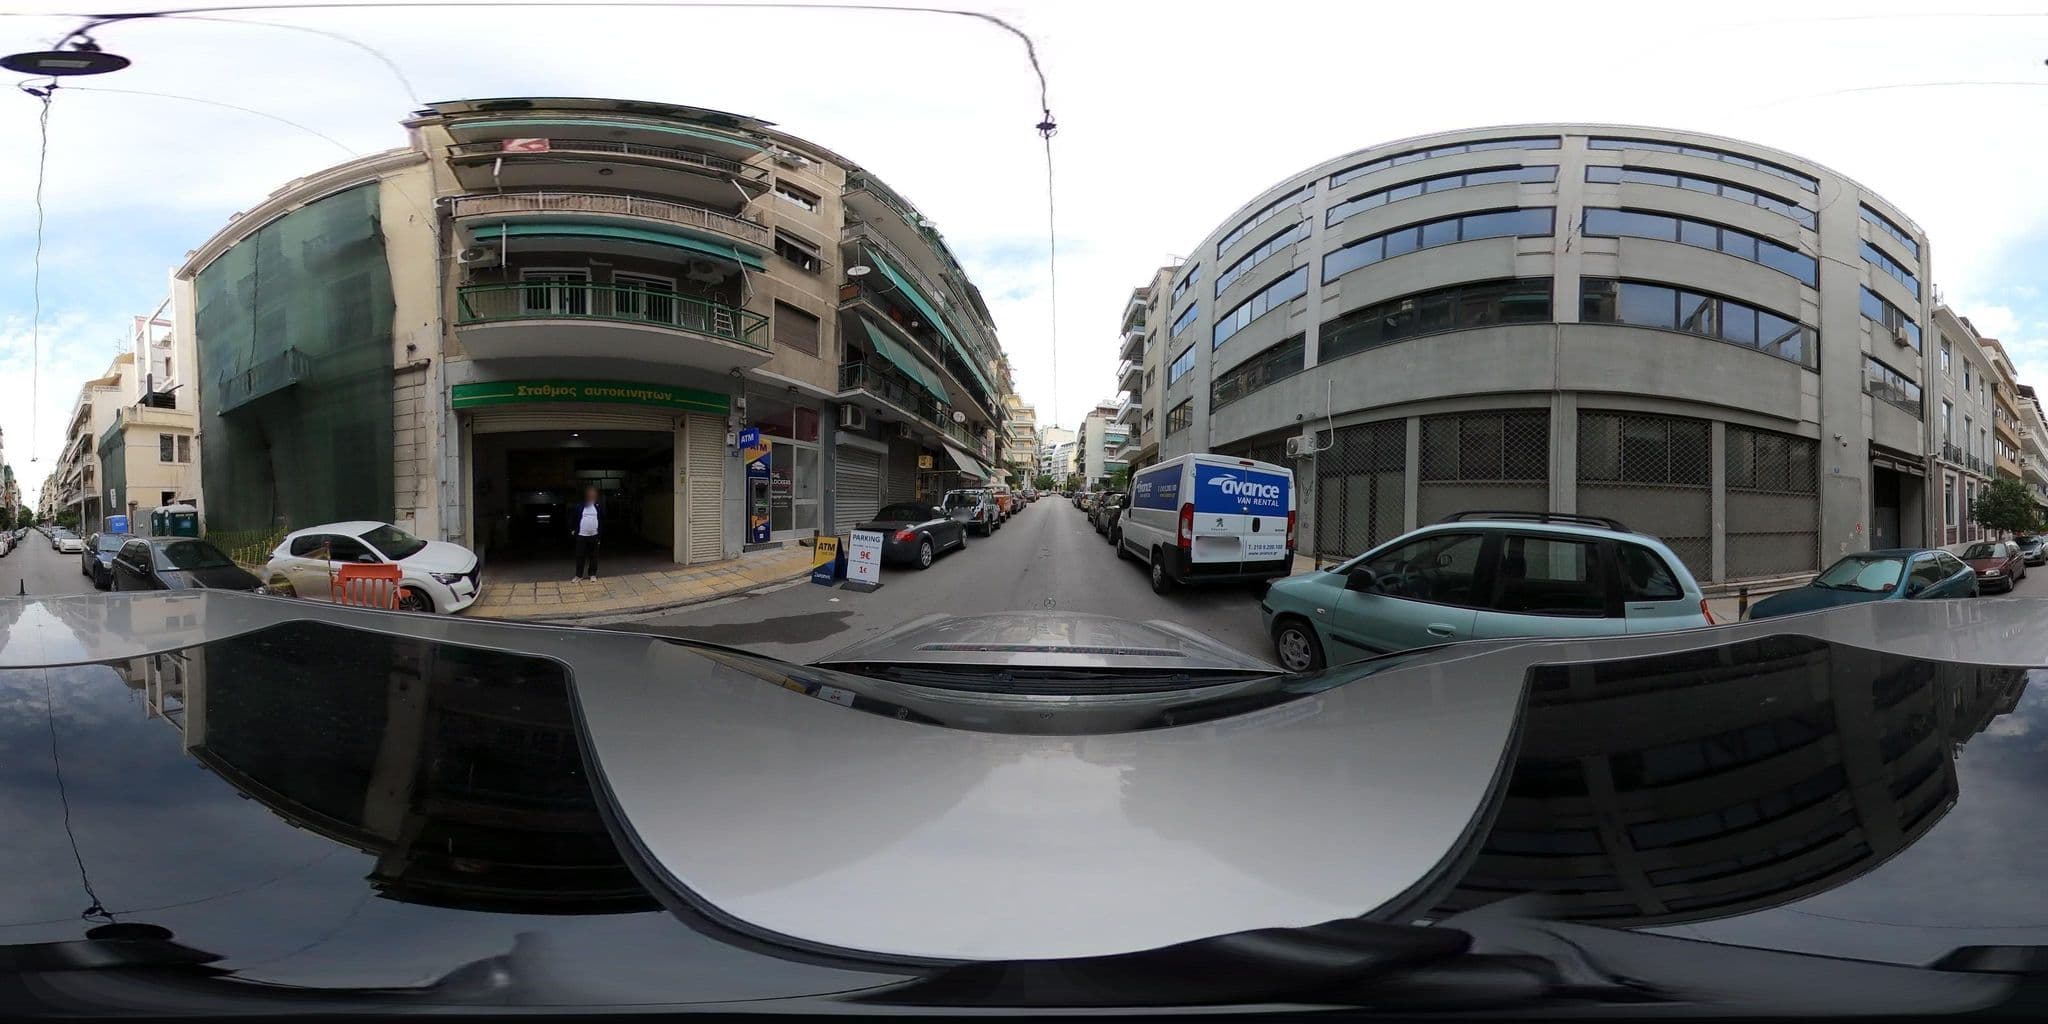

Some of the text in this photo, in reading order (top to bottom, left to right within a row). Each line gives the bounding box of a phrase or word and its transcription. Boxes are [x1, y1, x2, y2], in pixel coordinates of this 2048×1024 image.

[517, 384, 673, 401] Σταθμος αυτοκινητων
[740, 433, 755, 444] ATM
[1221, 480, 1280, 499] avance
[1237, 496, 1280, 507] VAN RENTAL
[852, 534, 881, 543] PARKING
[818, 542, 836, 552] ATM
[859, 550, 872, 560] 9€
[858, 566, 868, 574] 1€
